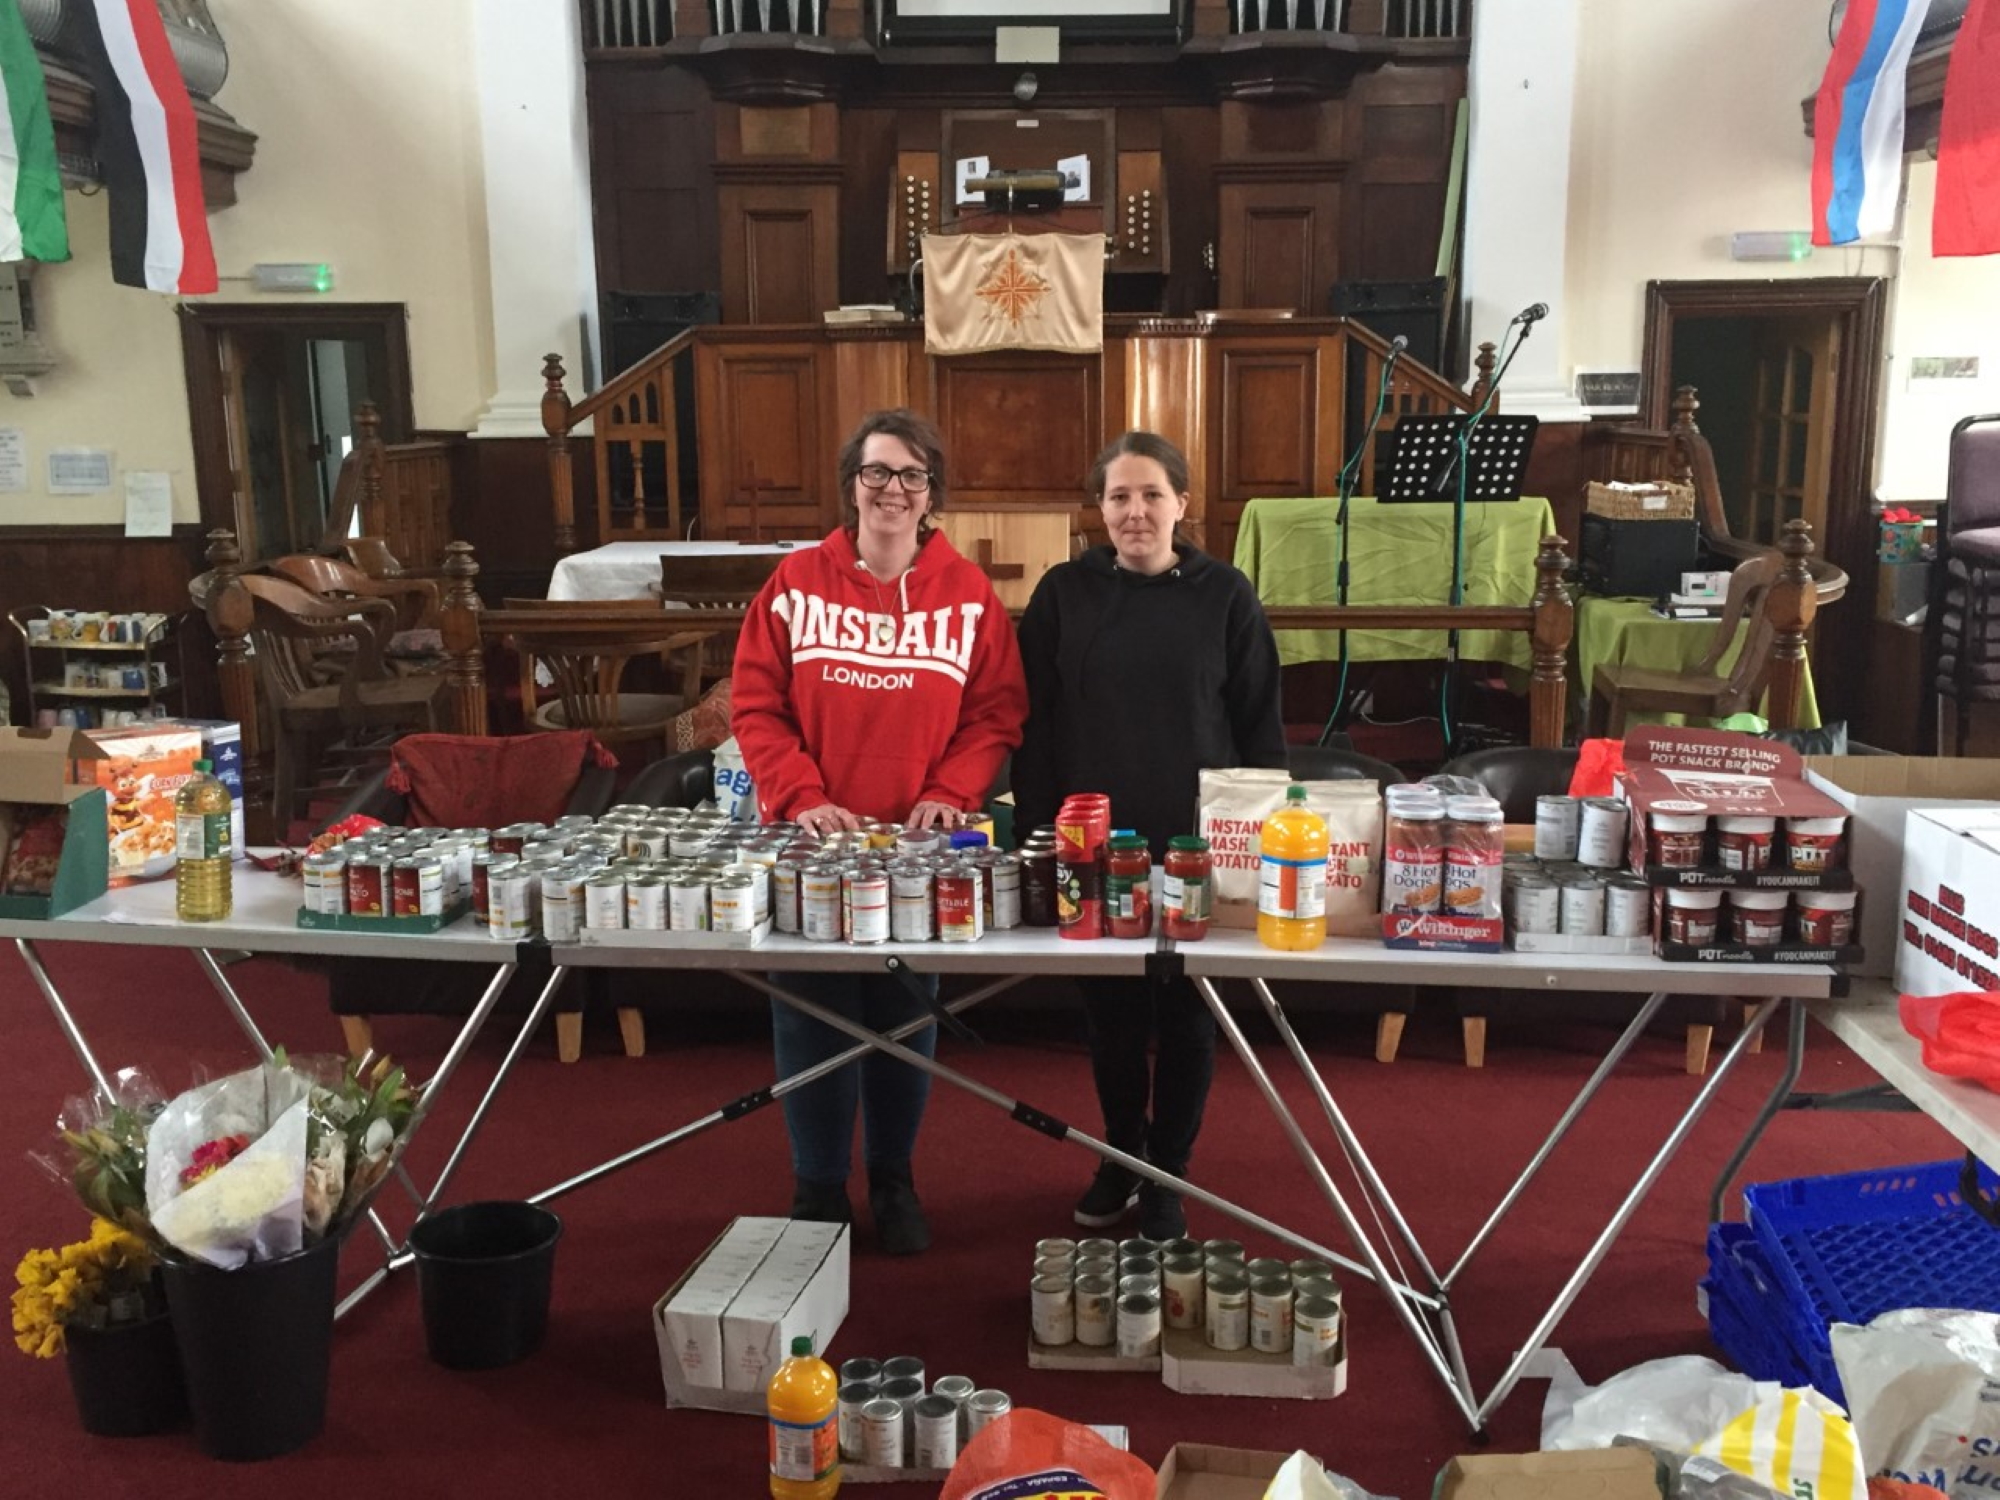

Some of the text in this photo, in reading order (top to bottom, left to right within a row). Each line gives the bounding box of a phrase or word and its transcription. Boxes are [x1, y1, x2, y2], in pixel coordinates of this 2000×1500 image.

[823, 665, 914, 690] LONDON
[1648, 740, 1782, 763] THE FASTEST SELLING
[1650, 753, 1676, 764] POT
[1679, 755, 1721, 768] SNACK
[1207, 818, 1263, 834] INSTAN
[1330, 842, 1370, 856] TANT
[1213, 853, 1261, 870] OTATO
[1413, 866, 1437, 877] Hot
[1451, 866, 1476, 879] Hot
[1679, 872, 1705, 884] POT
[1326, 874, 1362, 888] ATO
[1394, 875, 1433, 888] Dogs
[1446, 879, 1471, 889] ogs
[1418, 921, 1491, 939] Wikinger
[1698, 949, 1724, 960] POT
